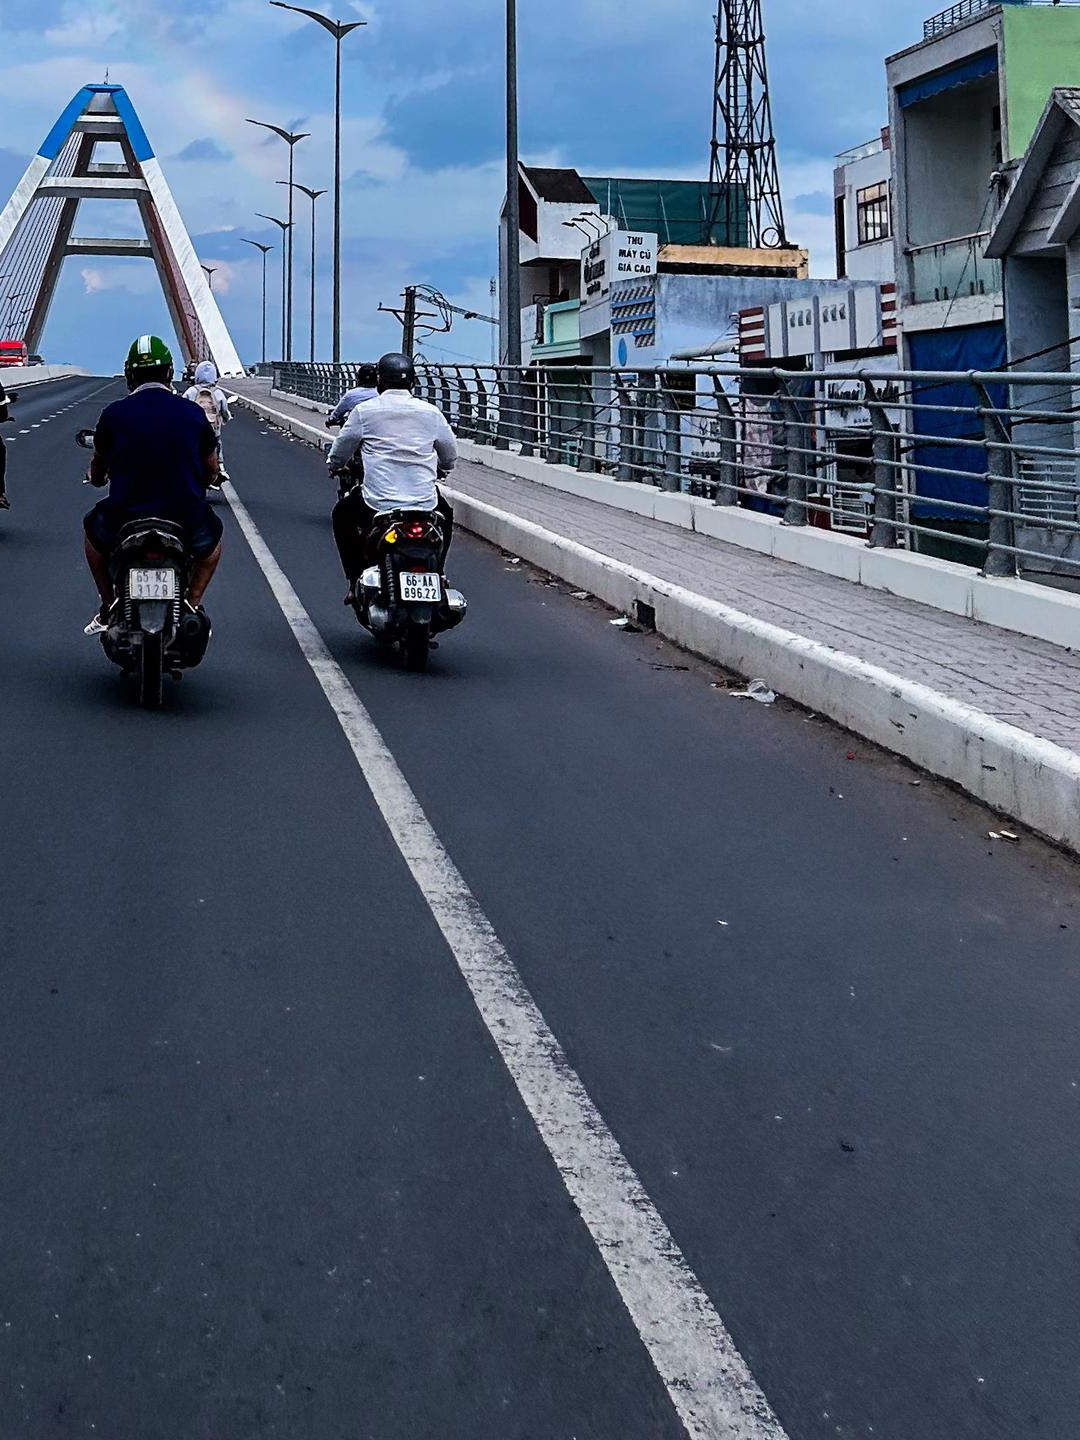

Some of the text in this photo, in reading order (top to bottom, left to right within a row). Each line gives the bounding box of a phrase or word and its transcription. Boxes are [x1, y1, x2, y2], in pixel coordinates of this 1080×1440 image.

[627, 235, 643, 245] THU
[618, 246, 638, 258] MÁY
[617, 261, 632, 272] GIÁ
[634, 264, 651, 274] CAO
[406, 575, 434, 587] 66-AA
[404, 587, 438, 600] 896.22
